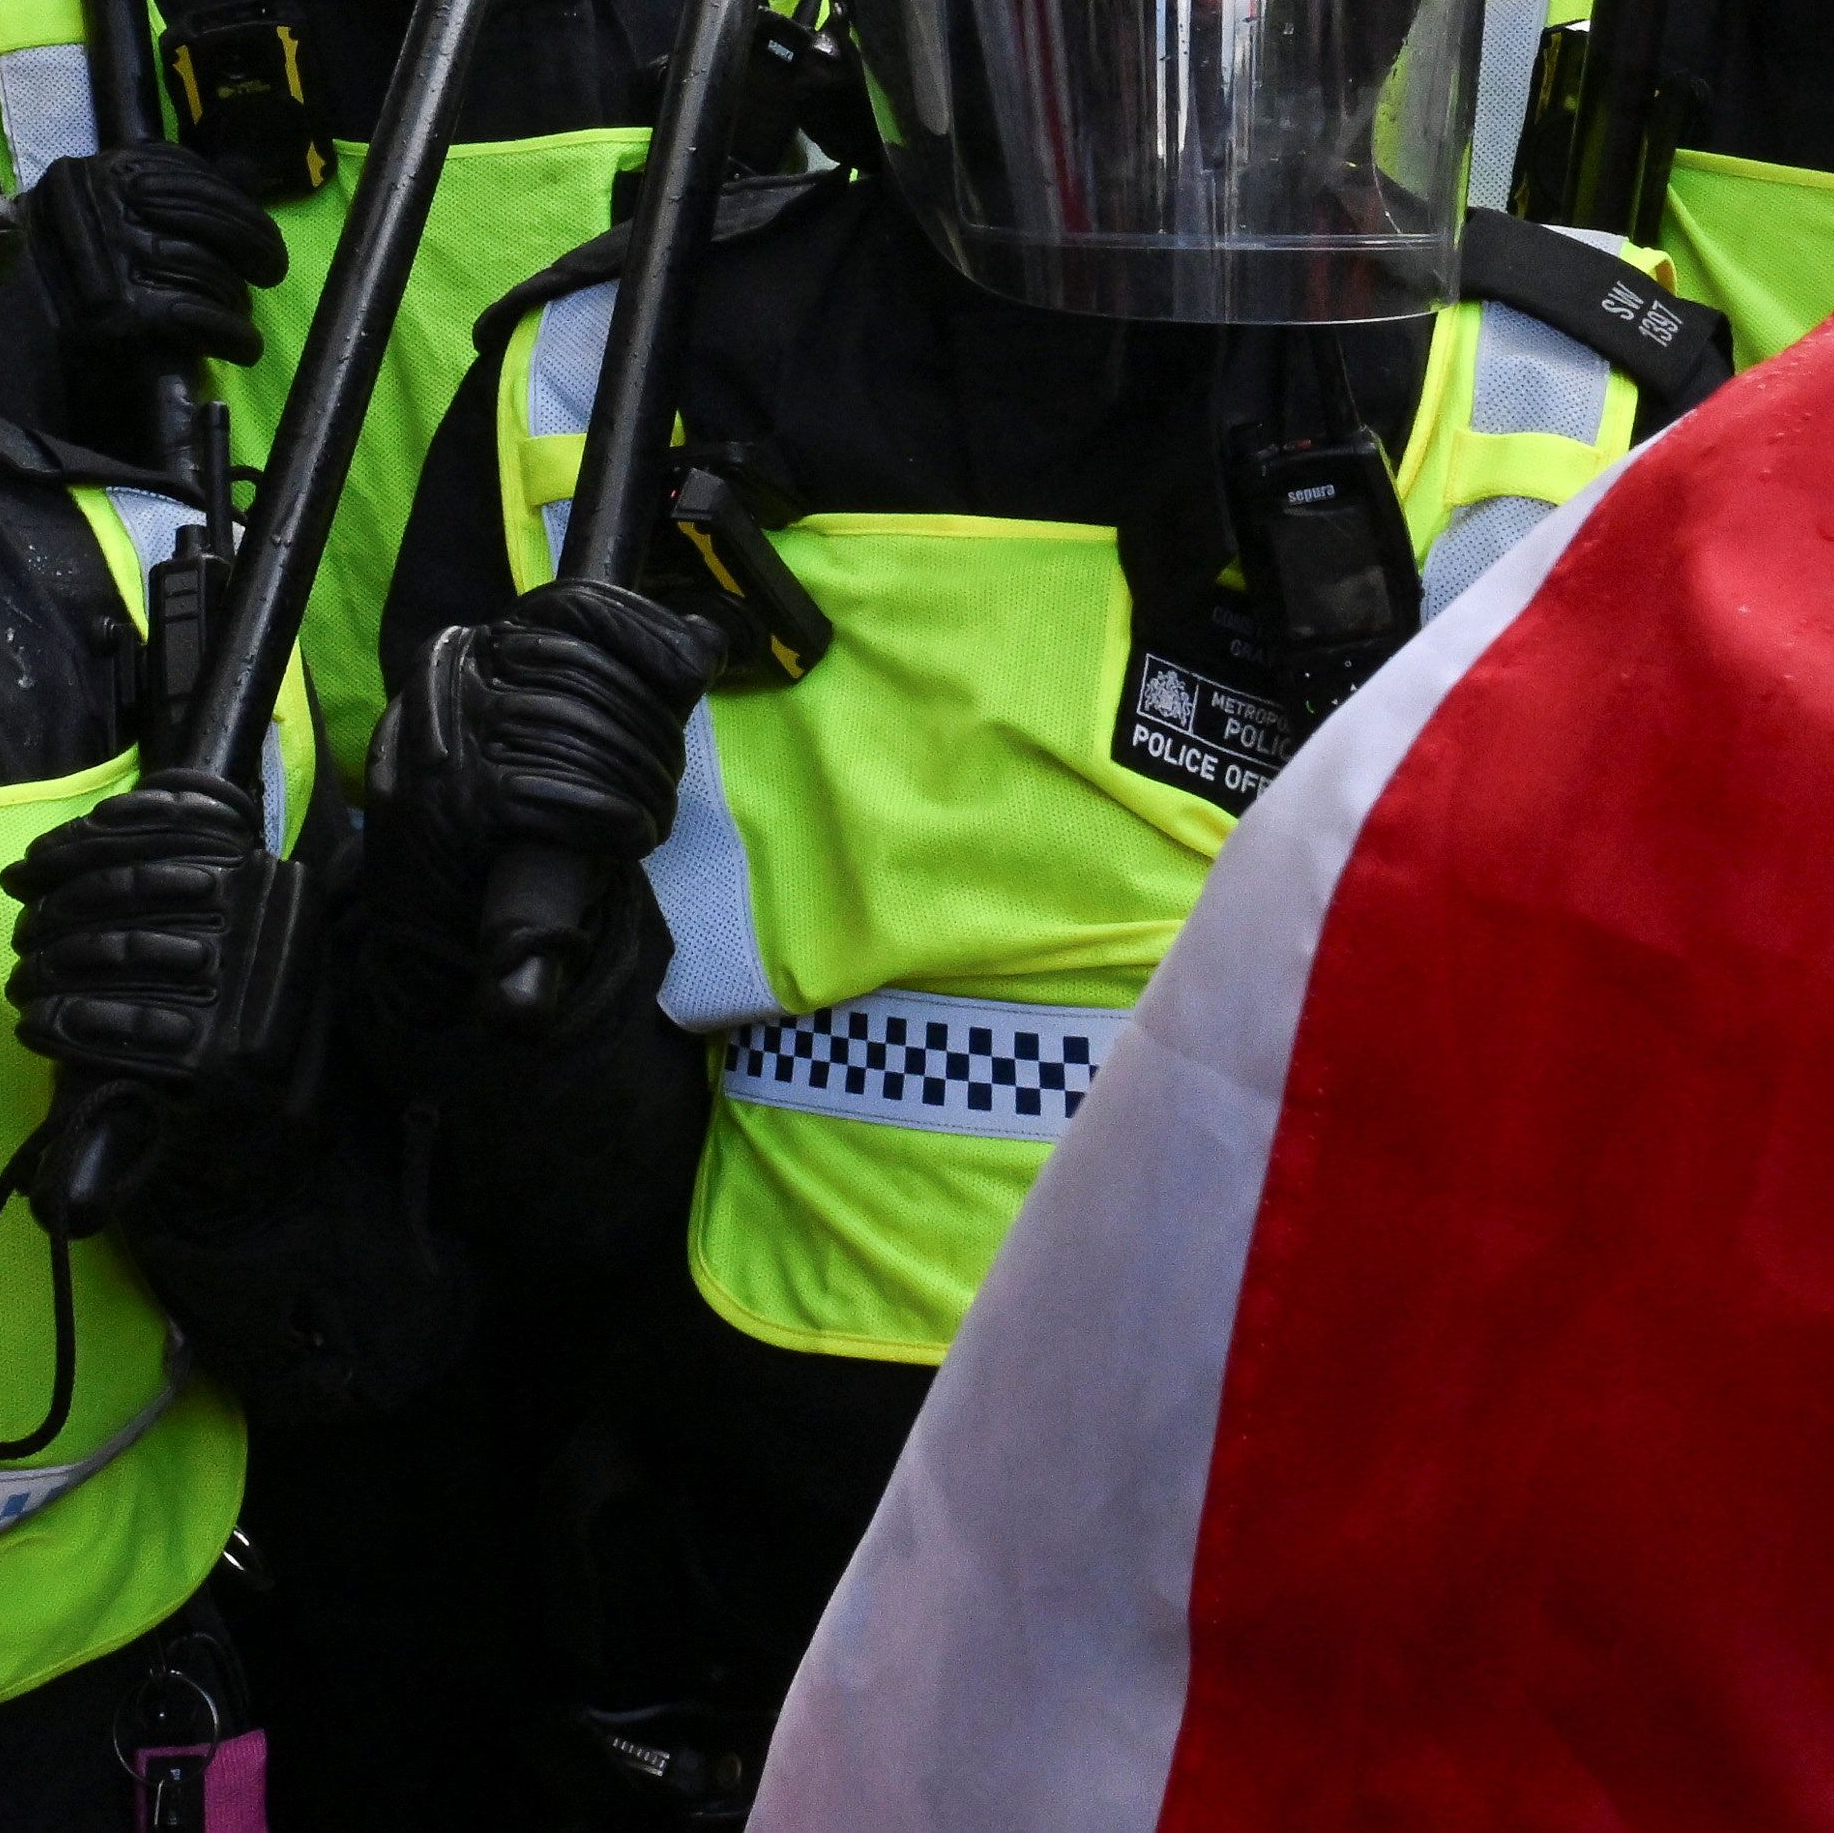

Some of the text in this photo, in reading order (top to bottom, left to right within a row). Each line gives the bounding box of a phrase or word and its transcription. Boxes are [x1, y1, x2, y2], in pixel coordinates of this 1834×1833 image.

[1601, 280, 1645, 321] SW
[1638, 299, 1684, 348] 1397
[1287, 484, 1336, 503] sepura
[1211, 690, 1290, 734] METROPO
[1223, 717, 1293, 760] POLIC
[1132, 723, 1271, 798] POLICE OFF
